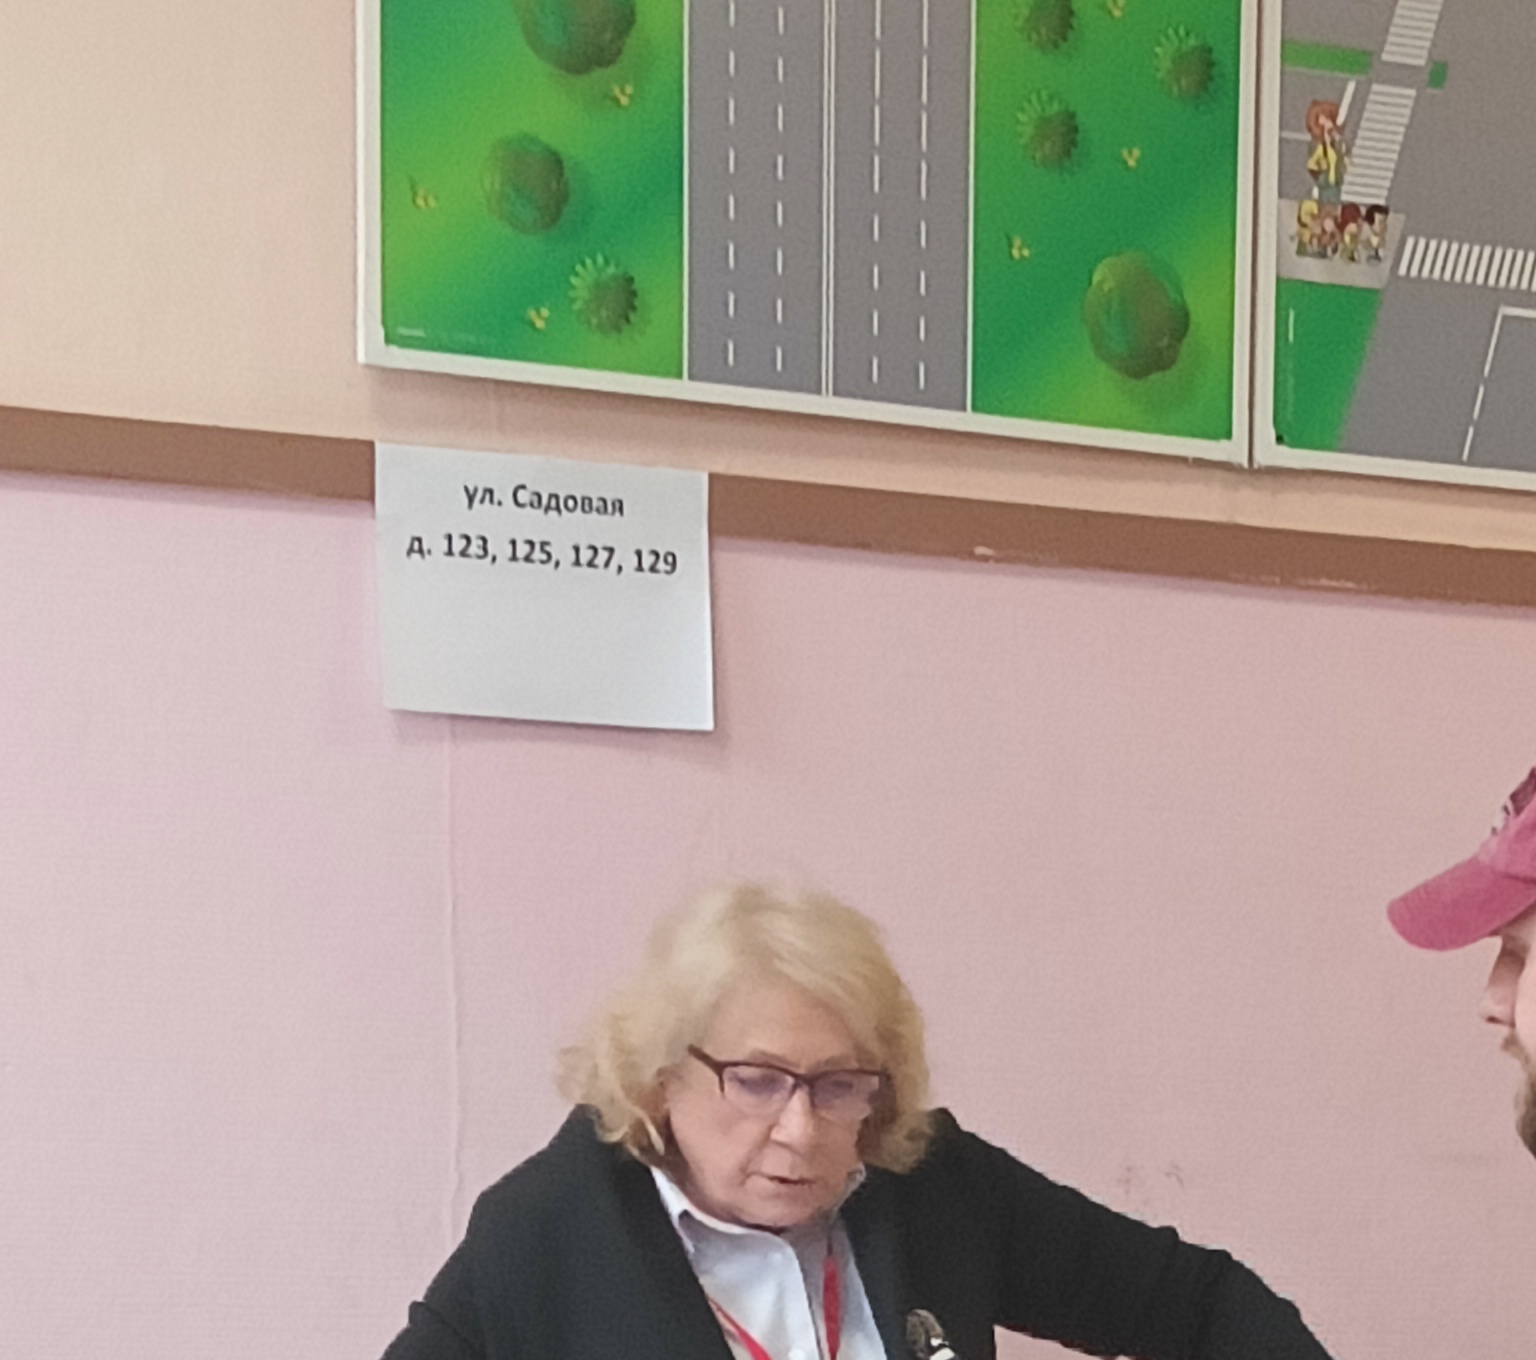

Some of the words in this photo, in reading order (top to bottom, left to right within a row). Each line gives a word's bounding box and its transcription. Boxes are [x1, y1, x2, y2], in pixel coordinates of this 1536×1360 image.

[463, 484, 503, 510] ул.
[511, 484, 625, 516] Садовая
[405, 535, 432, 559] д.
[443, 532, 497, 564] 123,
[507, 537, 560, 570] 125,
[570, 544, 623, 575] 127,
[633, 549, 678, 575] 129
